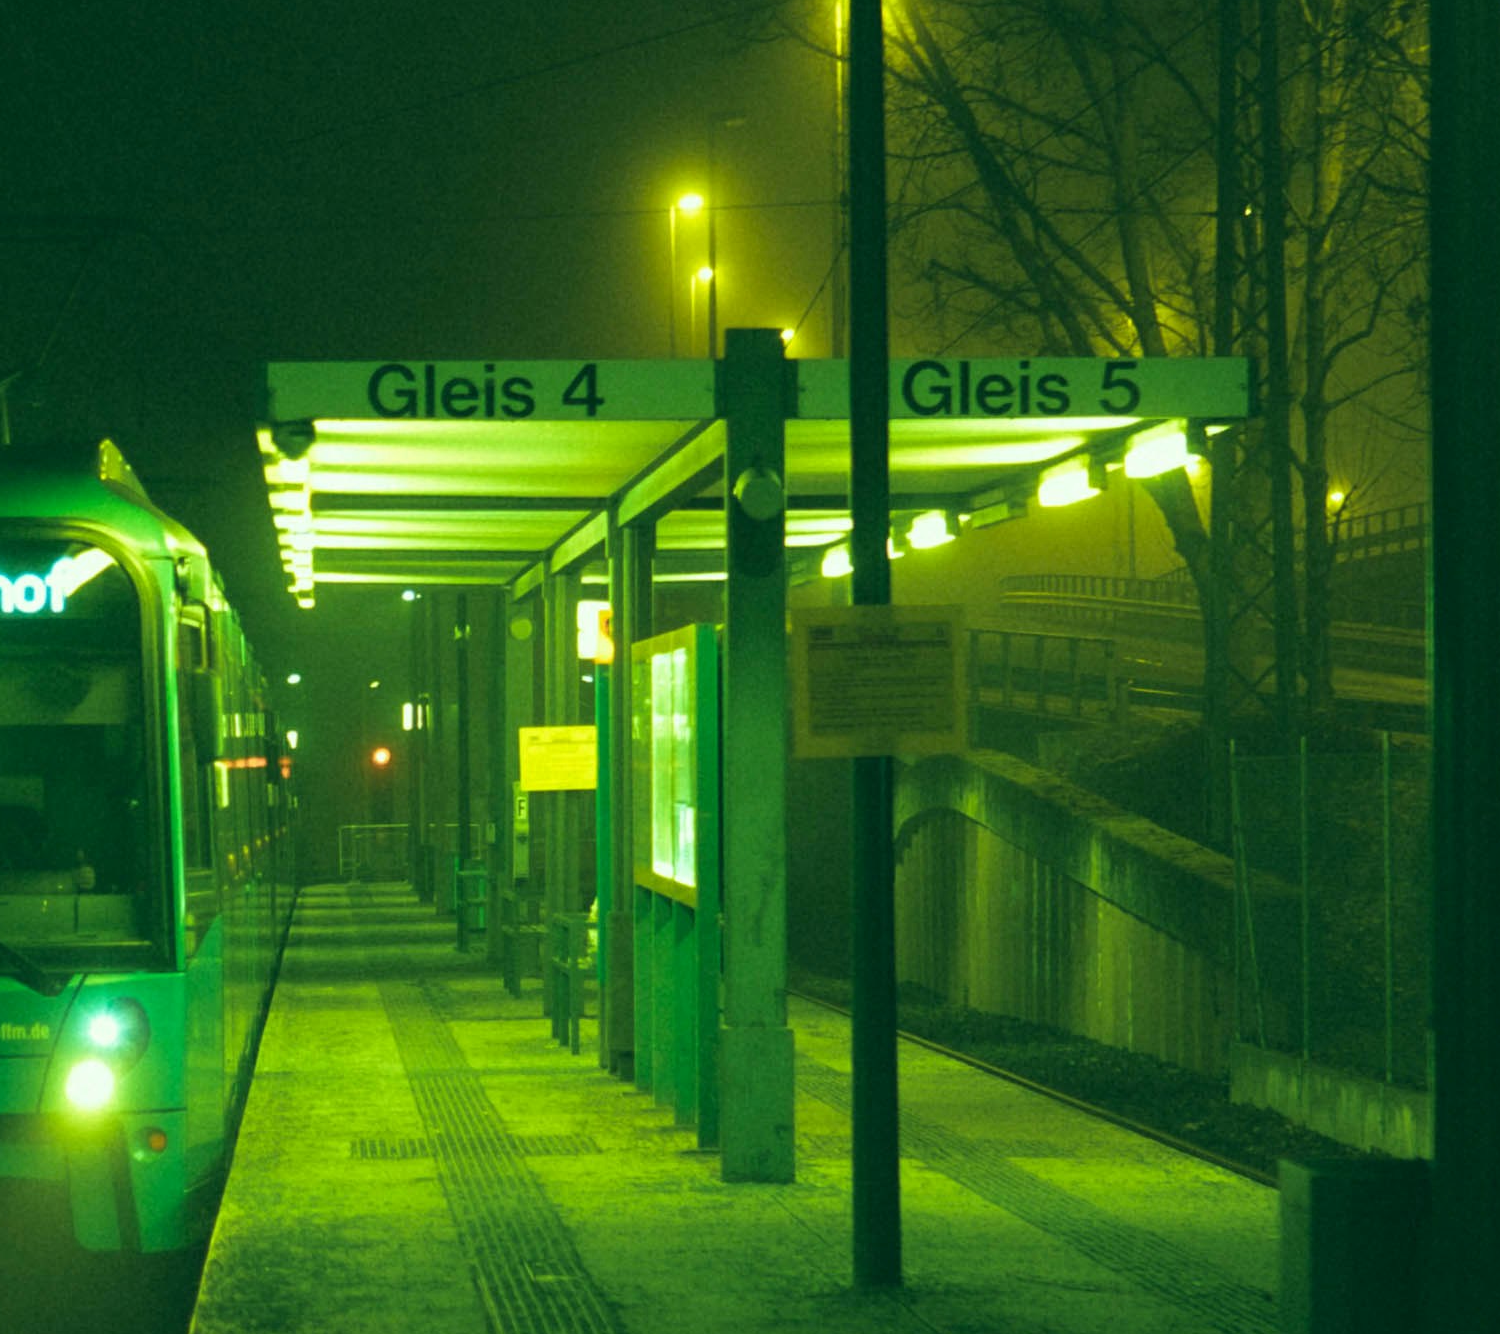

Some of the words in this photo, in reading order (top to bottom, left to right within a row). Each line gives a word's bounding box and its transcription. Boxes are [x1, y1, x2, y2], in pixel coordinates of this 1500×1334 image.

[367, 363, 535, 418] Gleis
[561, 363, 605, 417] 4
[902, 360, 1070, 415] Gleis
[1099, 360, 1141, 415] 5
